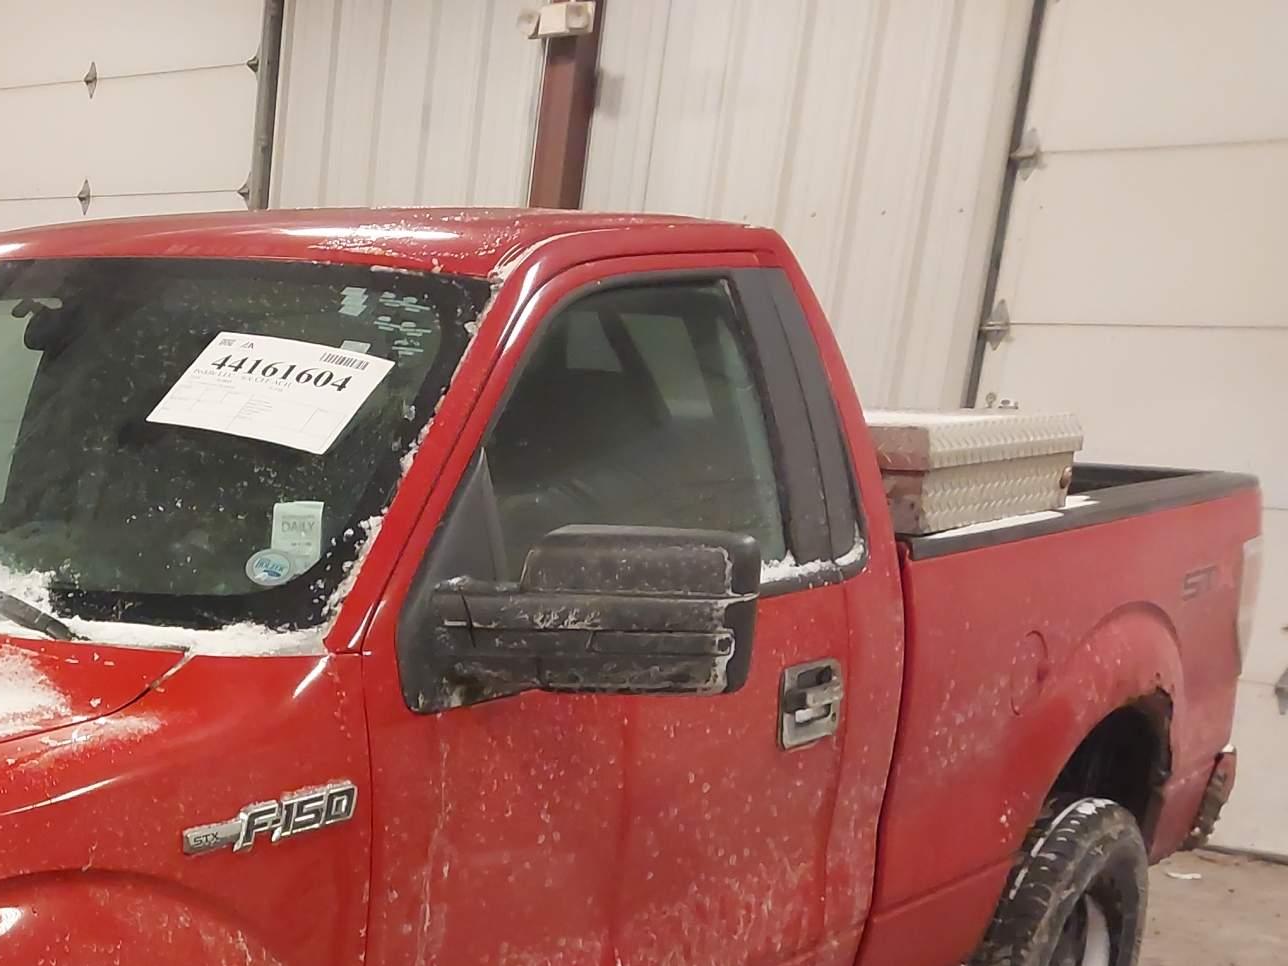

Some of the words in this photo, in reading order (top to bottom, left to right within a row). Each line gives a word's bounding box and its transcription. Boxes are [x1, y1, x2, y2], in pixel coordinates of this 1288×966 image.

[210, 354, 353, 392] 44161604
[193, 831, 220, 848] STX
[233, 783, 358, 852] F-150
